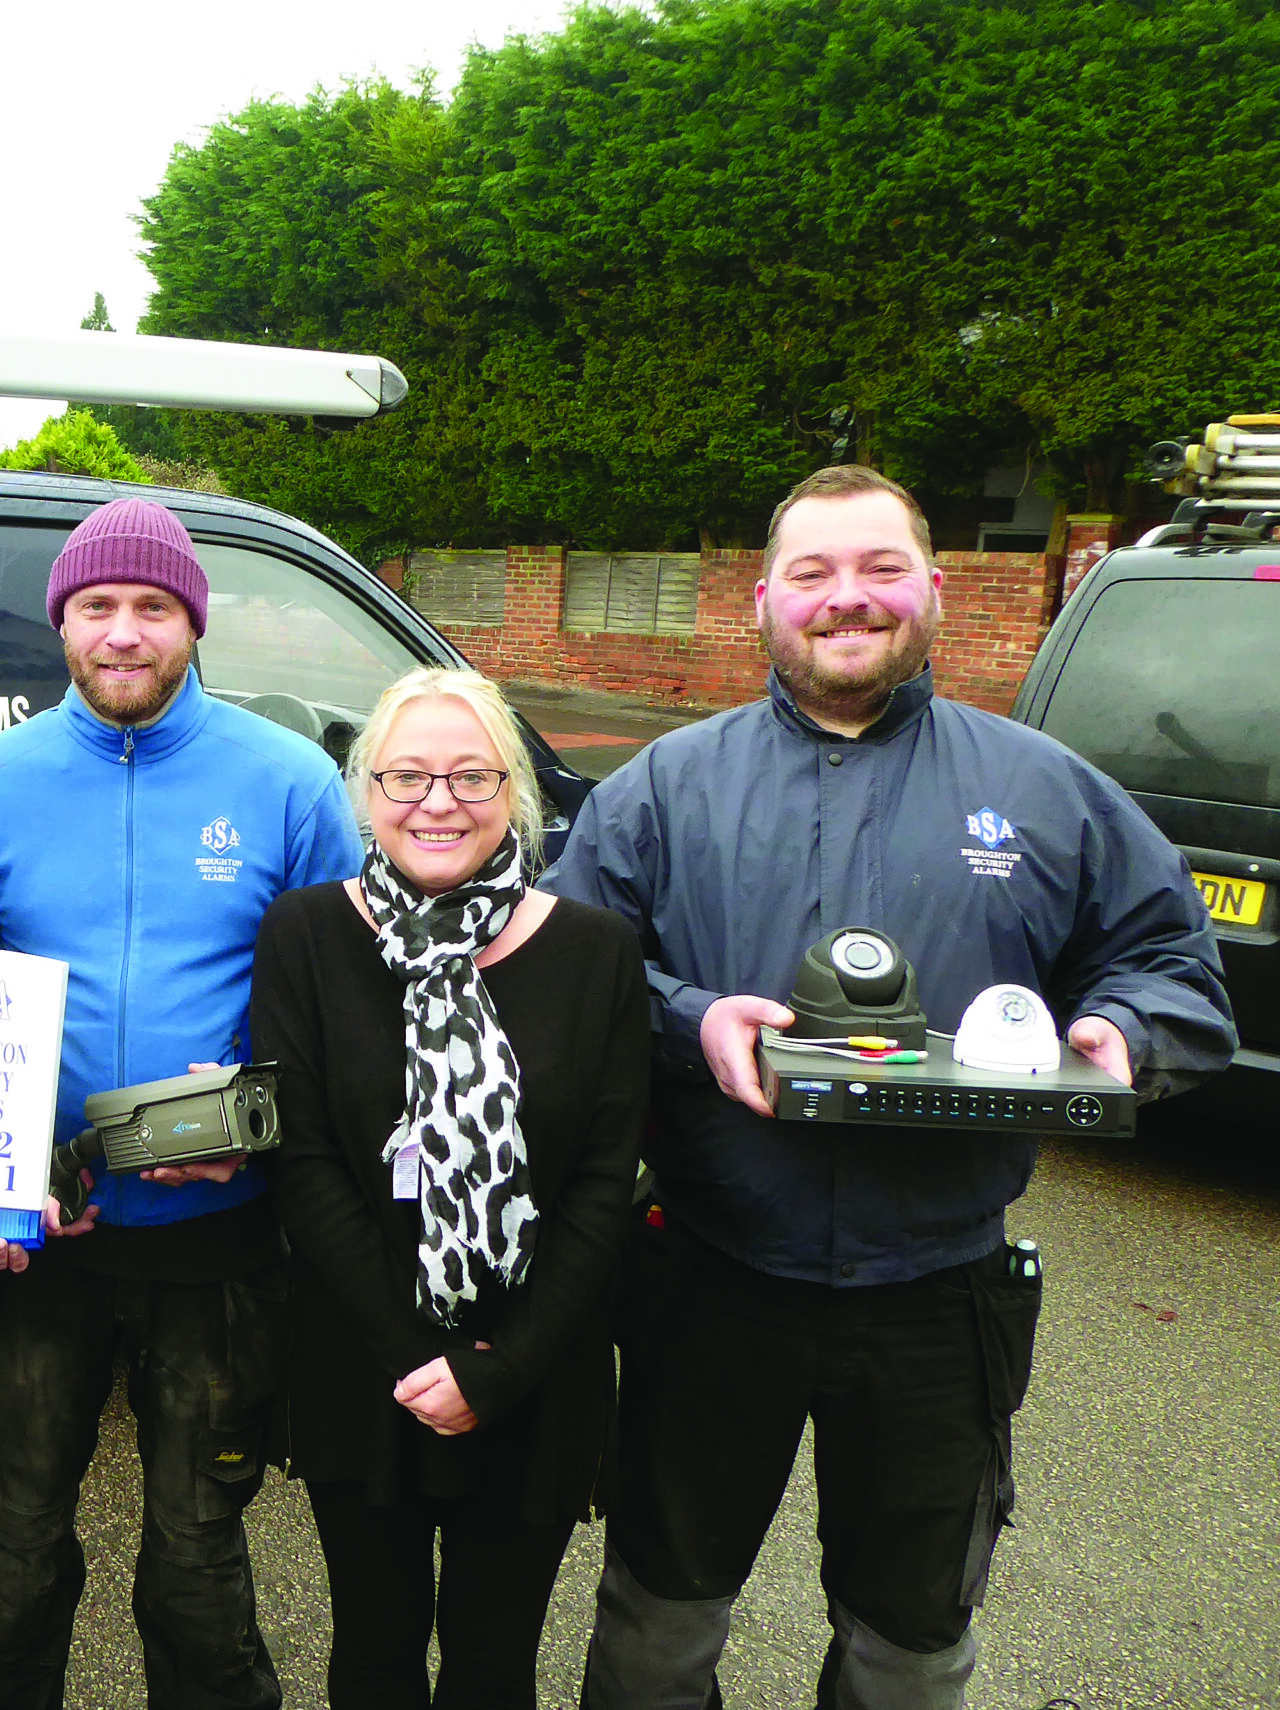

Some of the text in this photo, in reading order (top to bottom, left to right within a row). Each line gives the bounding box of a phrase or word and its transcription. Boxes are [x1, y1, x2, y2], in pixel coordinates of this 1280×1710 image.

[966, 812, 1016, 842] BSA
[201, 821, 240, 849] BSA
[960, 849, 1021, 861] BROUGHTON
[195, 857, 242, 867] BROUGHTON
[968, 858, 1014, 869] SECURITY
[199, 865, 237, 874] SECURITY
[972, 866, 1011, 877] ALARMS
[202, 873, 236, 882] ALARMS
[1200, 880, 1247, 915] DN
